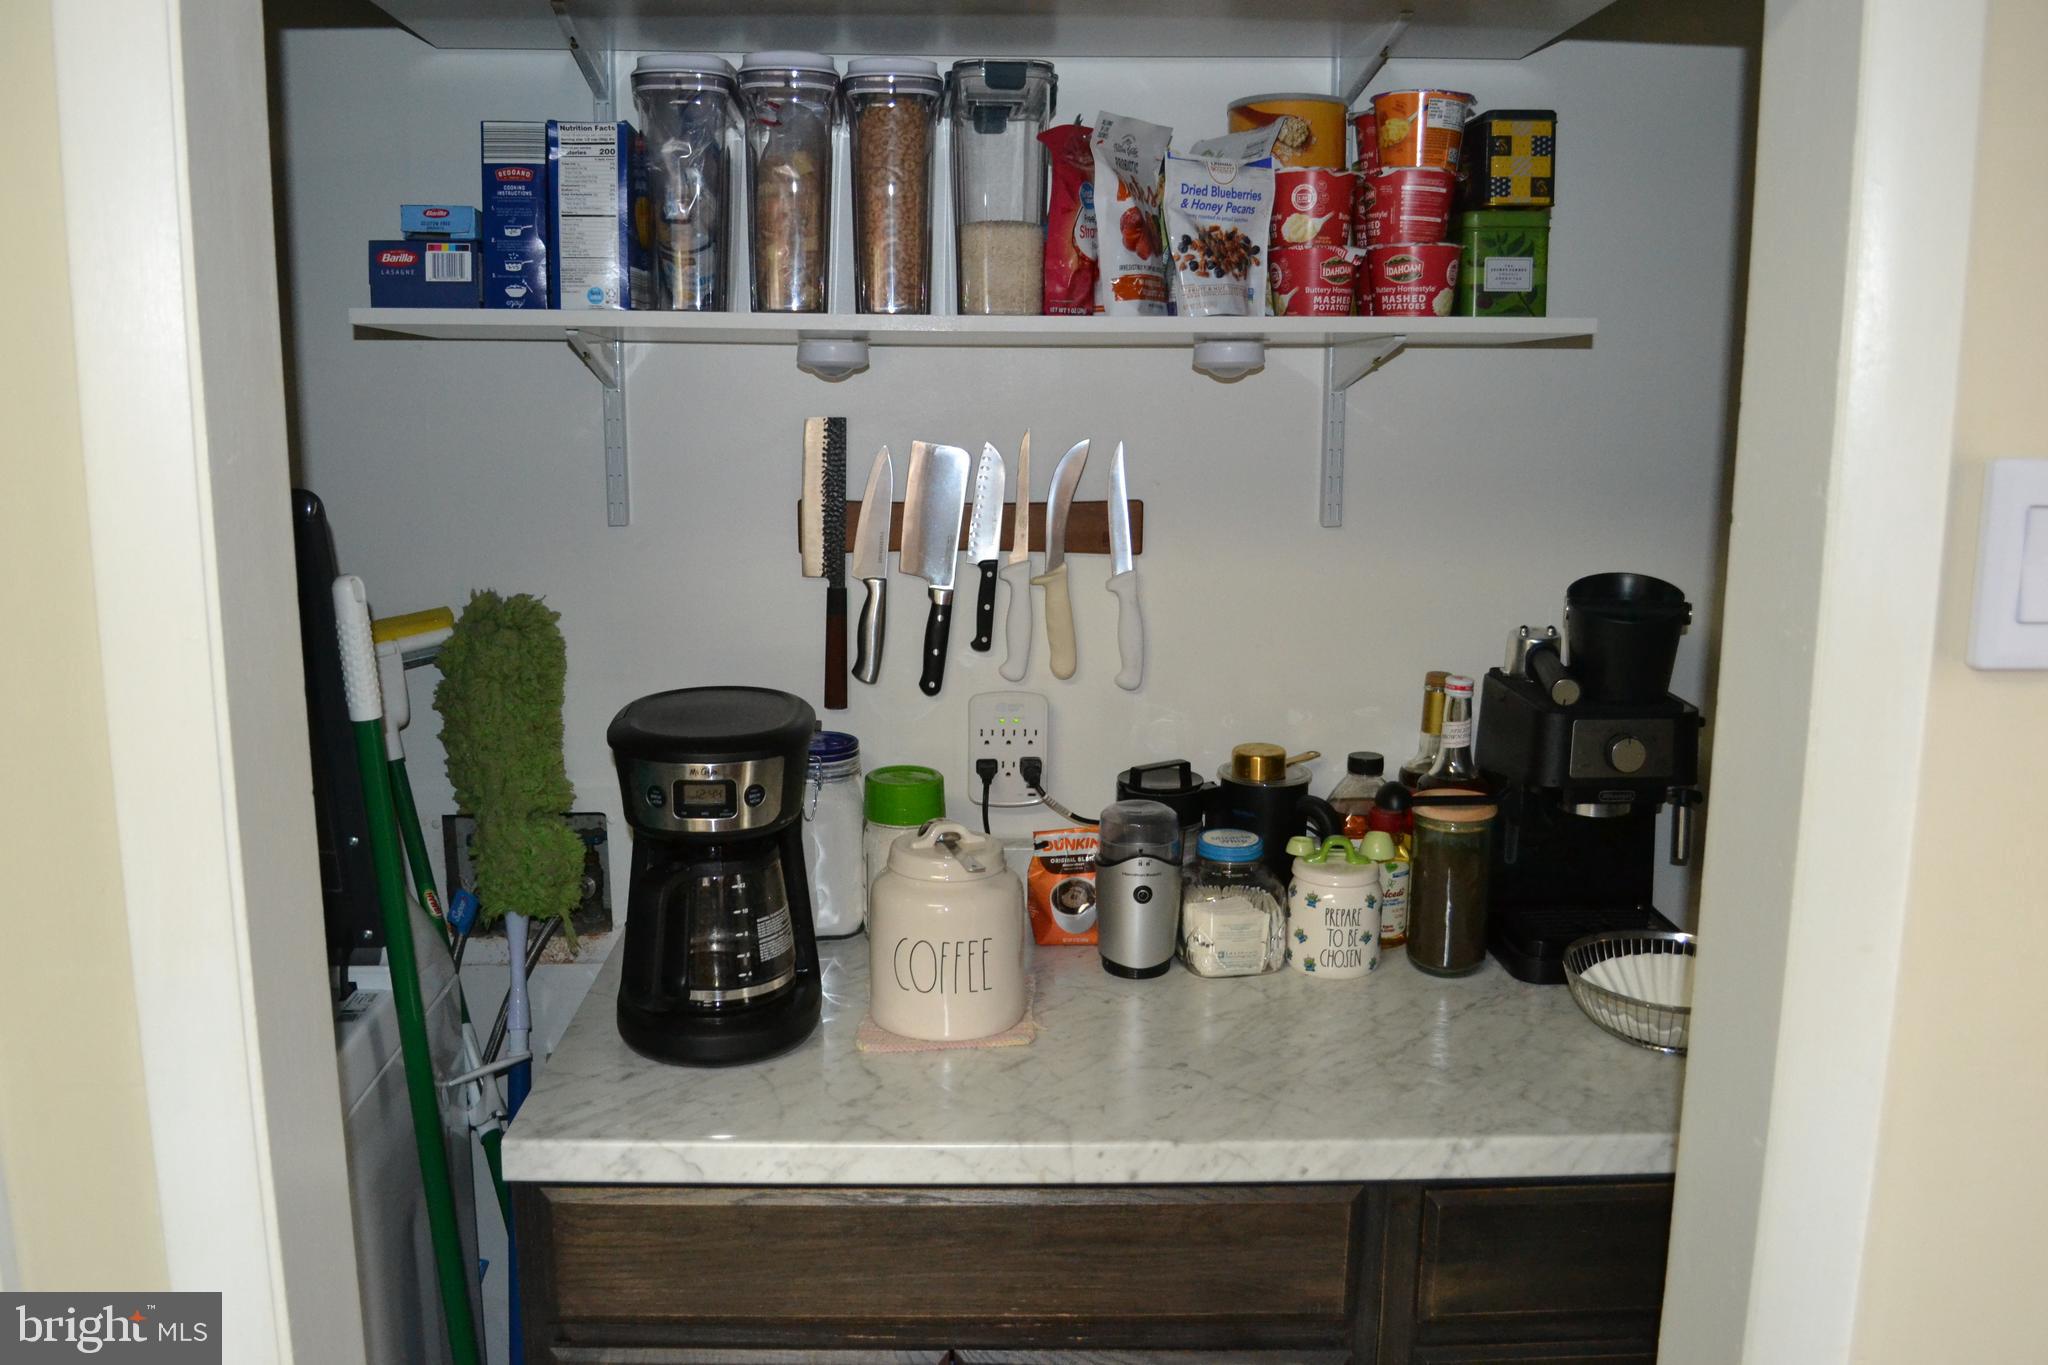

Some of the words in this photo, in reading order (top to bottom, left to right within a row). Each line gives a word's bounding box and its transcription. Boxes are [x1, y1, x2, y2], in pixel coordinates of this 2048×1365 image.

[1181, 183, 1208, 197] Dried
[1210, 185, 1262, 201] Blueberries
[1180, 198, 1188, 208] &
[1190, 198, 1222, 214] Honey
[1225, 202, 1256, 214] Pecans
[382, 253, 415, 263] Barilla
[1386, 263, 1421, 276] IDAHOAN
[1304, 286, 1331, 295] Buttery
[1376, 286, 1397, 294] Buttery
[1397, 285, 1436, 294] Homestyle
[1382, 294, 1426, 303] MASHED
[1382, 303, 1427, 311] POTATOES
[1325, 907, 1362, 927] PREPARE
[1327, 928, 1344, 948] TO
[1347, 928, 1359, 948] BE
[893, 937, 993, 994] COFFEE
[1320, 948, 1362, 969] CHOSEN
